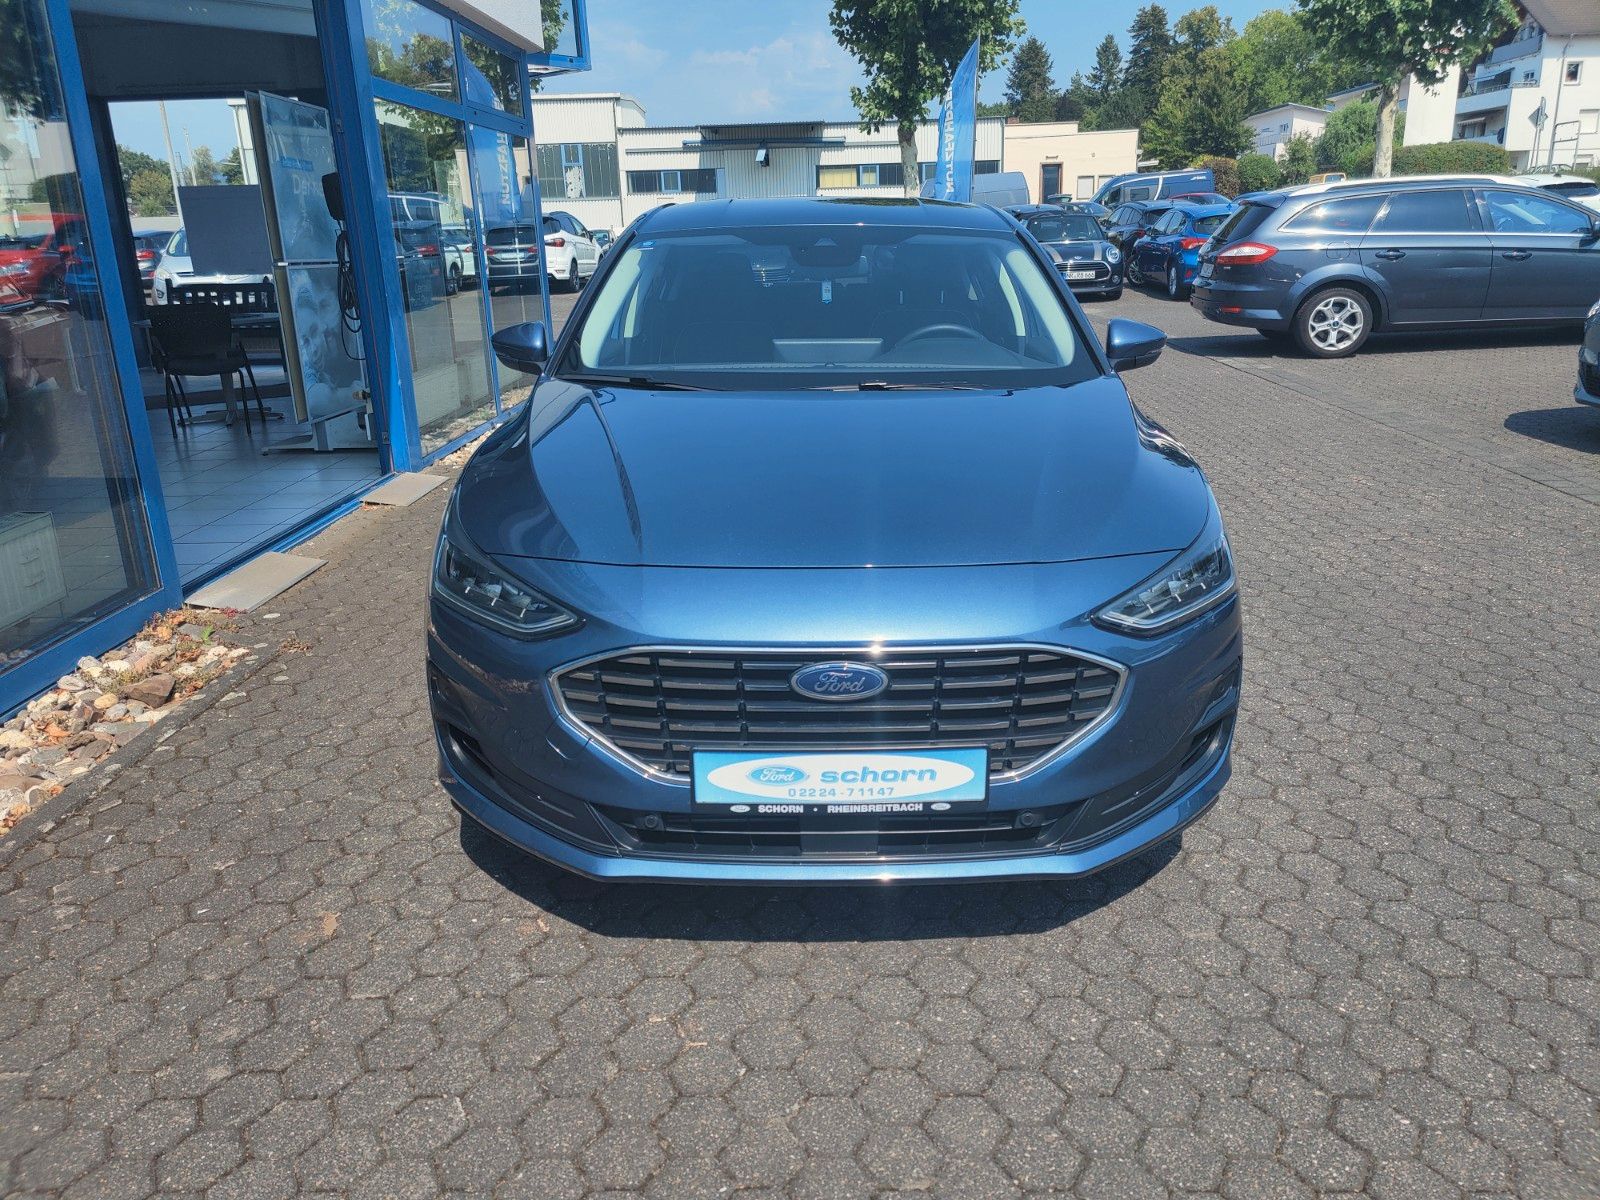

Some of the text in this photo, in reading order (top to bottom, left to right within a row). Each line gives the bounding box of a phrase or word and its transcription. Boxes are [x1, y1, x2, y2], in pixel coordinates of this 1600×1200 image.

[814, 671, 866, 692] Ford
[760, 766, 938, 783] Ford schorn
[757, 804, 804, 814] SCHORN
[827, 802, 923, 814] RHEINBREITBACH
